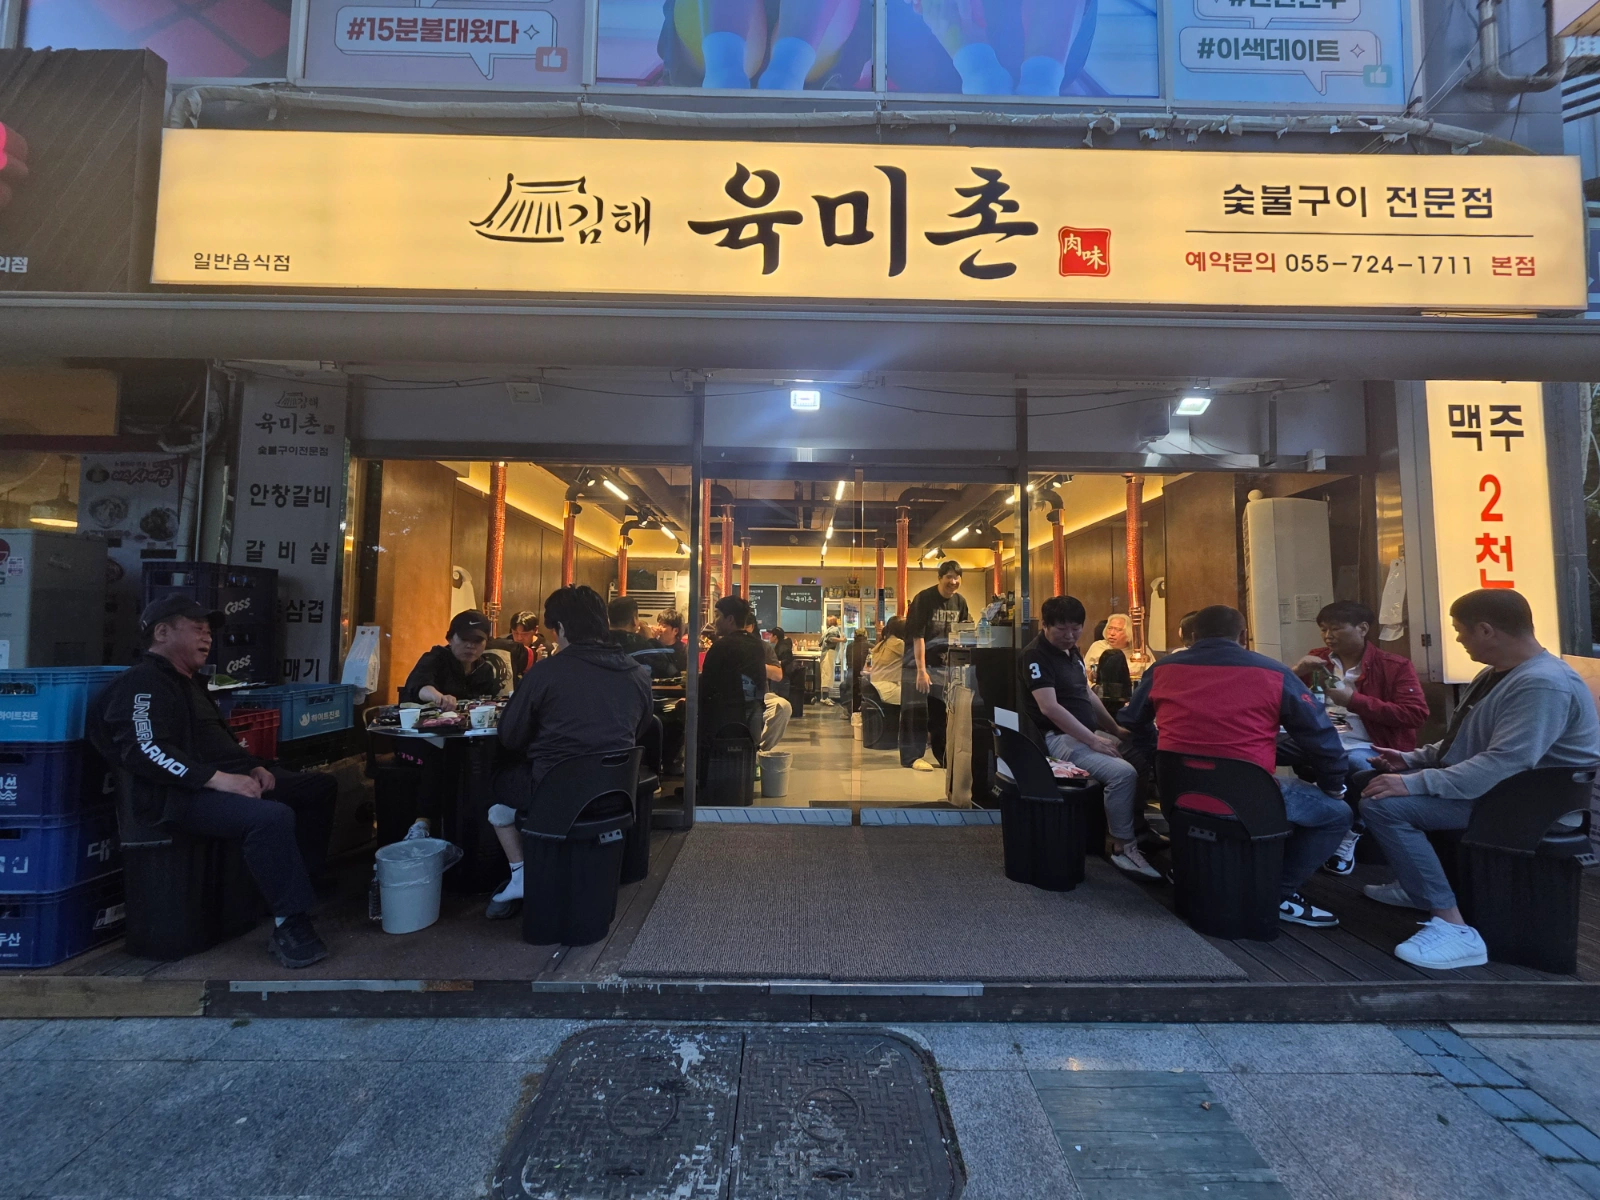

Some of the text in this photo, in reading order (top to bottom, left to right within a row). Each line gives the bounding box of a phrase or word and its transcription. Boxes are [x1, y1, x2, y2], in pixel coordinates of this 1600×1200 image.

[347, 17, 519, 44] #15분불태웠다
[1197, 37, 1340, 62] #이색데이트
[1222, 183, 1494, 219] 숯불구이 전문점
[568, 160, 1039, 280] 김해 육미촌
[193, 253, 291, 273] 일반음식점
[1185, 251, 1536, 277] 예약문의 055-724-1711 본점
[255, 412, 321, 435] 육미촌
[1448, 404, 1524, 452] 맥주
[250, 483, 331, 508] 안창갈비
[225, 597, 251, 615] Cass
[277, 600, 324, 623] 삼겹
[226, 654, 251, 674] Cass
[277, 659, 320, 683] 매기
[1029, 662, 1042, 680] 3
